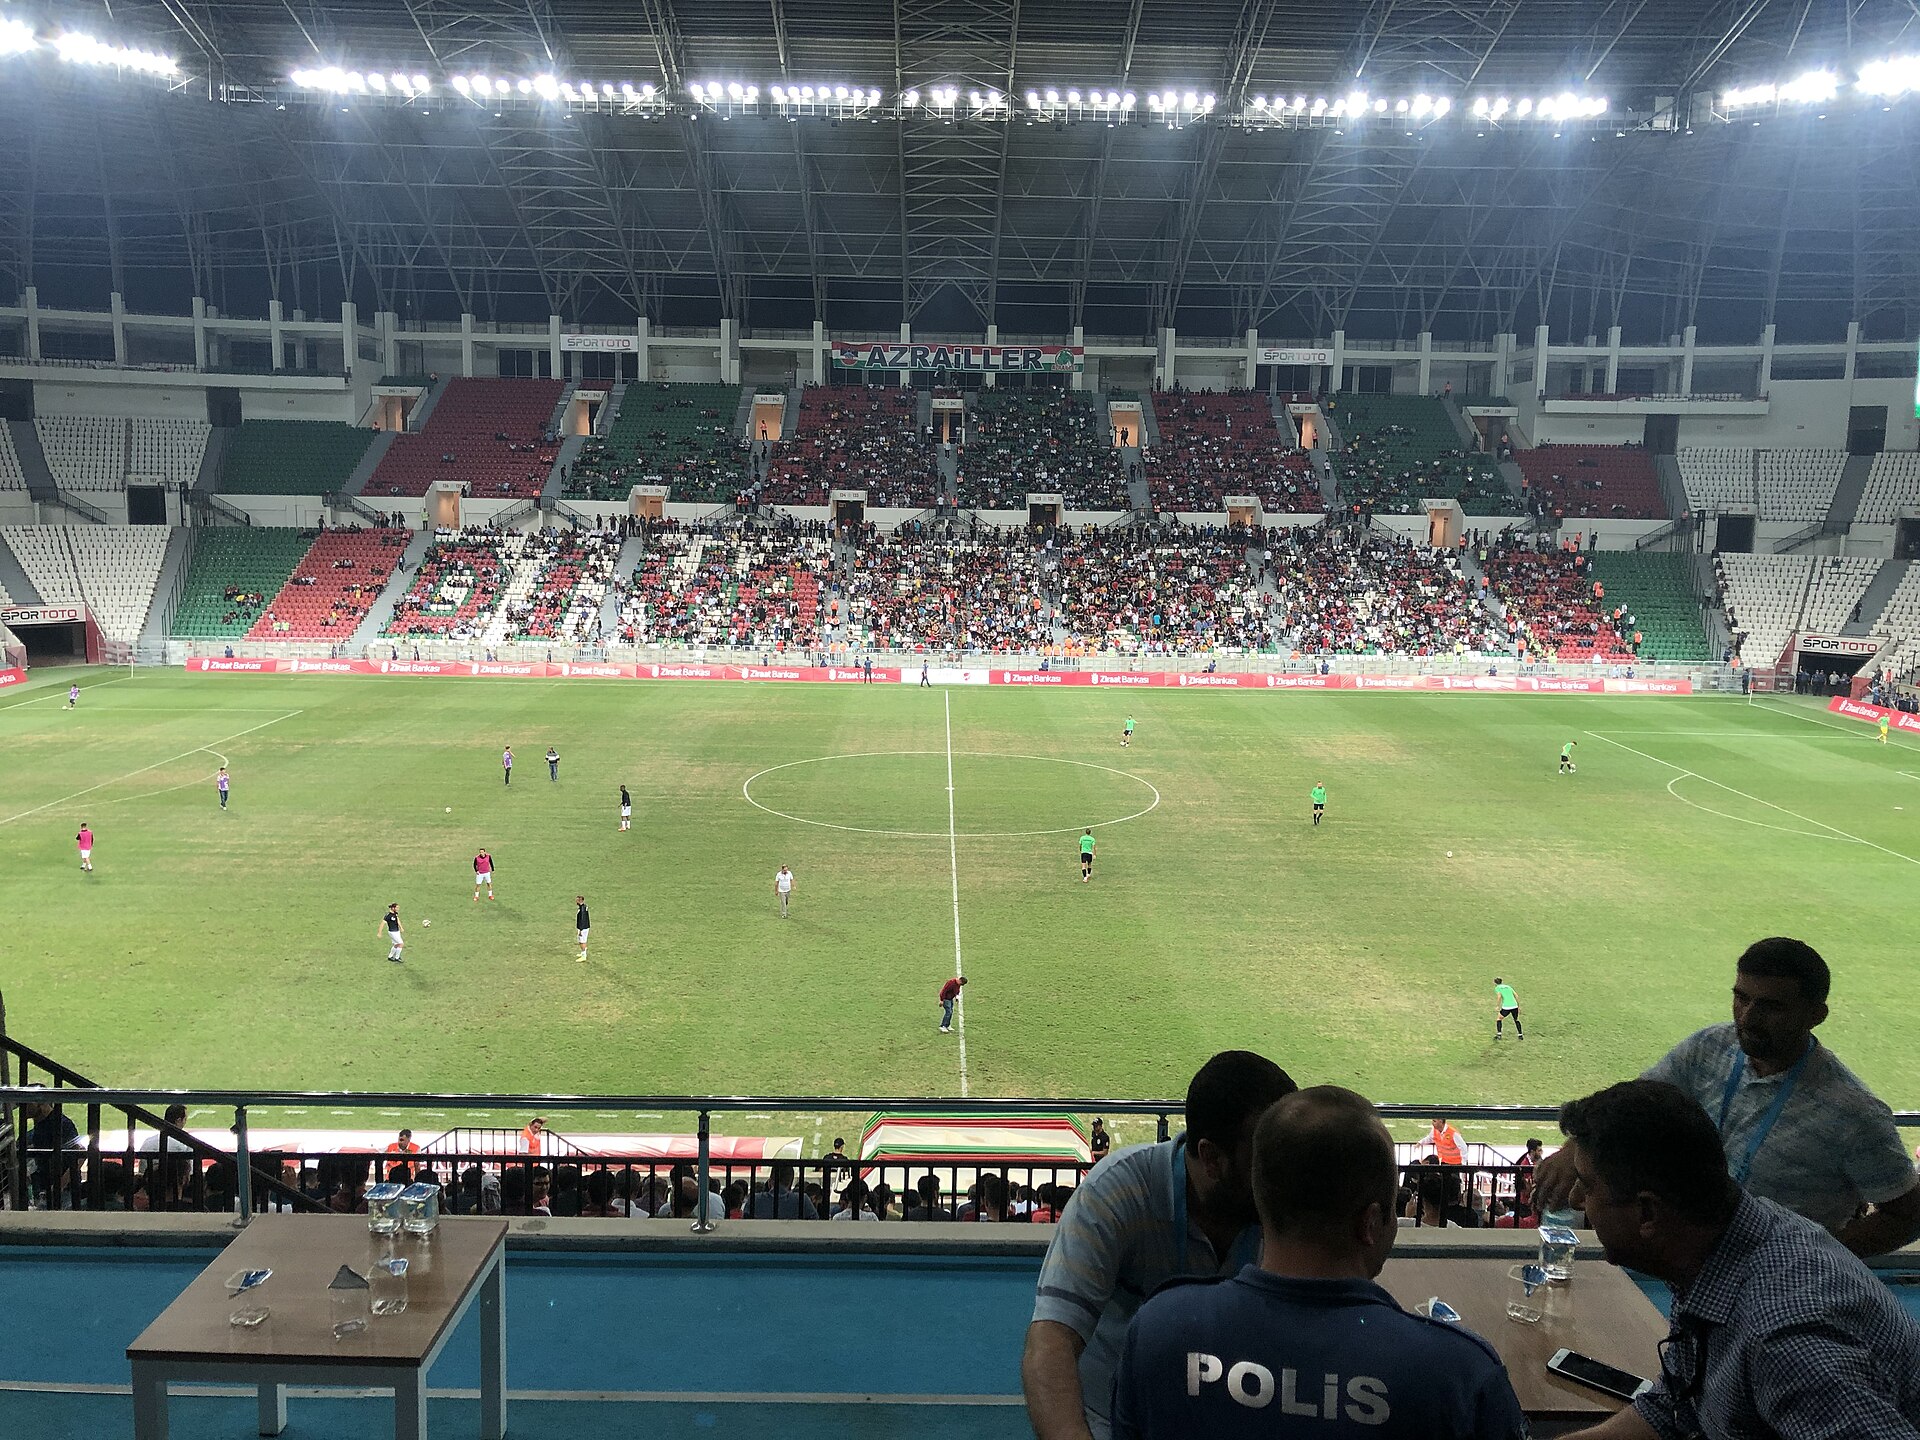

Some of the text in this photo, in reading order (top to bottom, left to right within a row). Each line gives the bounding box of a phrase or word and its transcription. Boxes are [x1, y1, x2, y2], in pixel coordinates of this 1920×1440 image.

[210, 661, 232, 670] Ziraat
[480, 665, 502, 673] Ziraat
[660, 667, 681, 675] Ziraat
[1012, 674, 1033, 682] Ziraat
[1100, 675, 1121, 683] Ziraat
[1276, 677, 1297, 686] Ziraat
